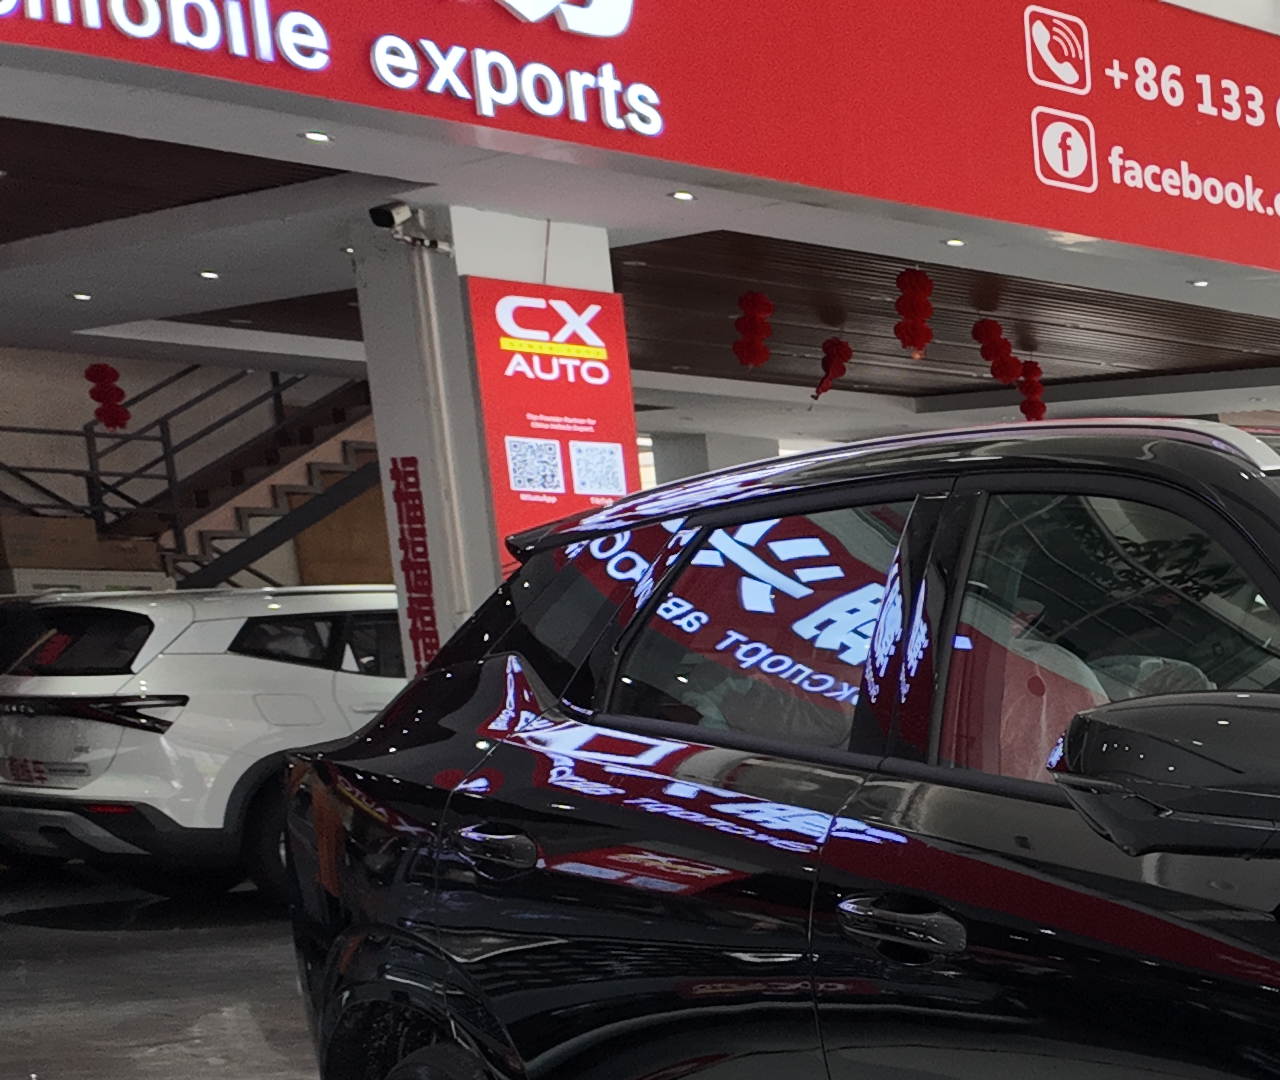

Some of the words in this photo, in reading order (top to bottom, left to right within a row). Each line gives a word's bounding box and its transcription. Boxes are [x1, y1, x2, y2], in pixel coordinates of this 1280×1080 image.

[369, 33, 664, 138] exports
[1104, 56, 1185, 107] +86
[1195, 73, 1266, 127] 133
[495, 295, 607, 348] CX
[504, 353, 611, 386] AUTO
